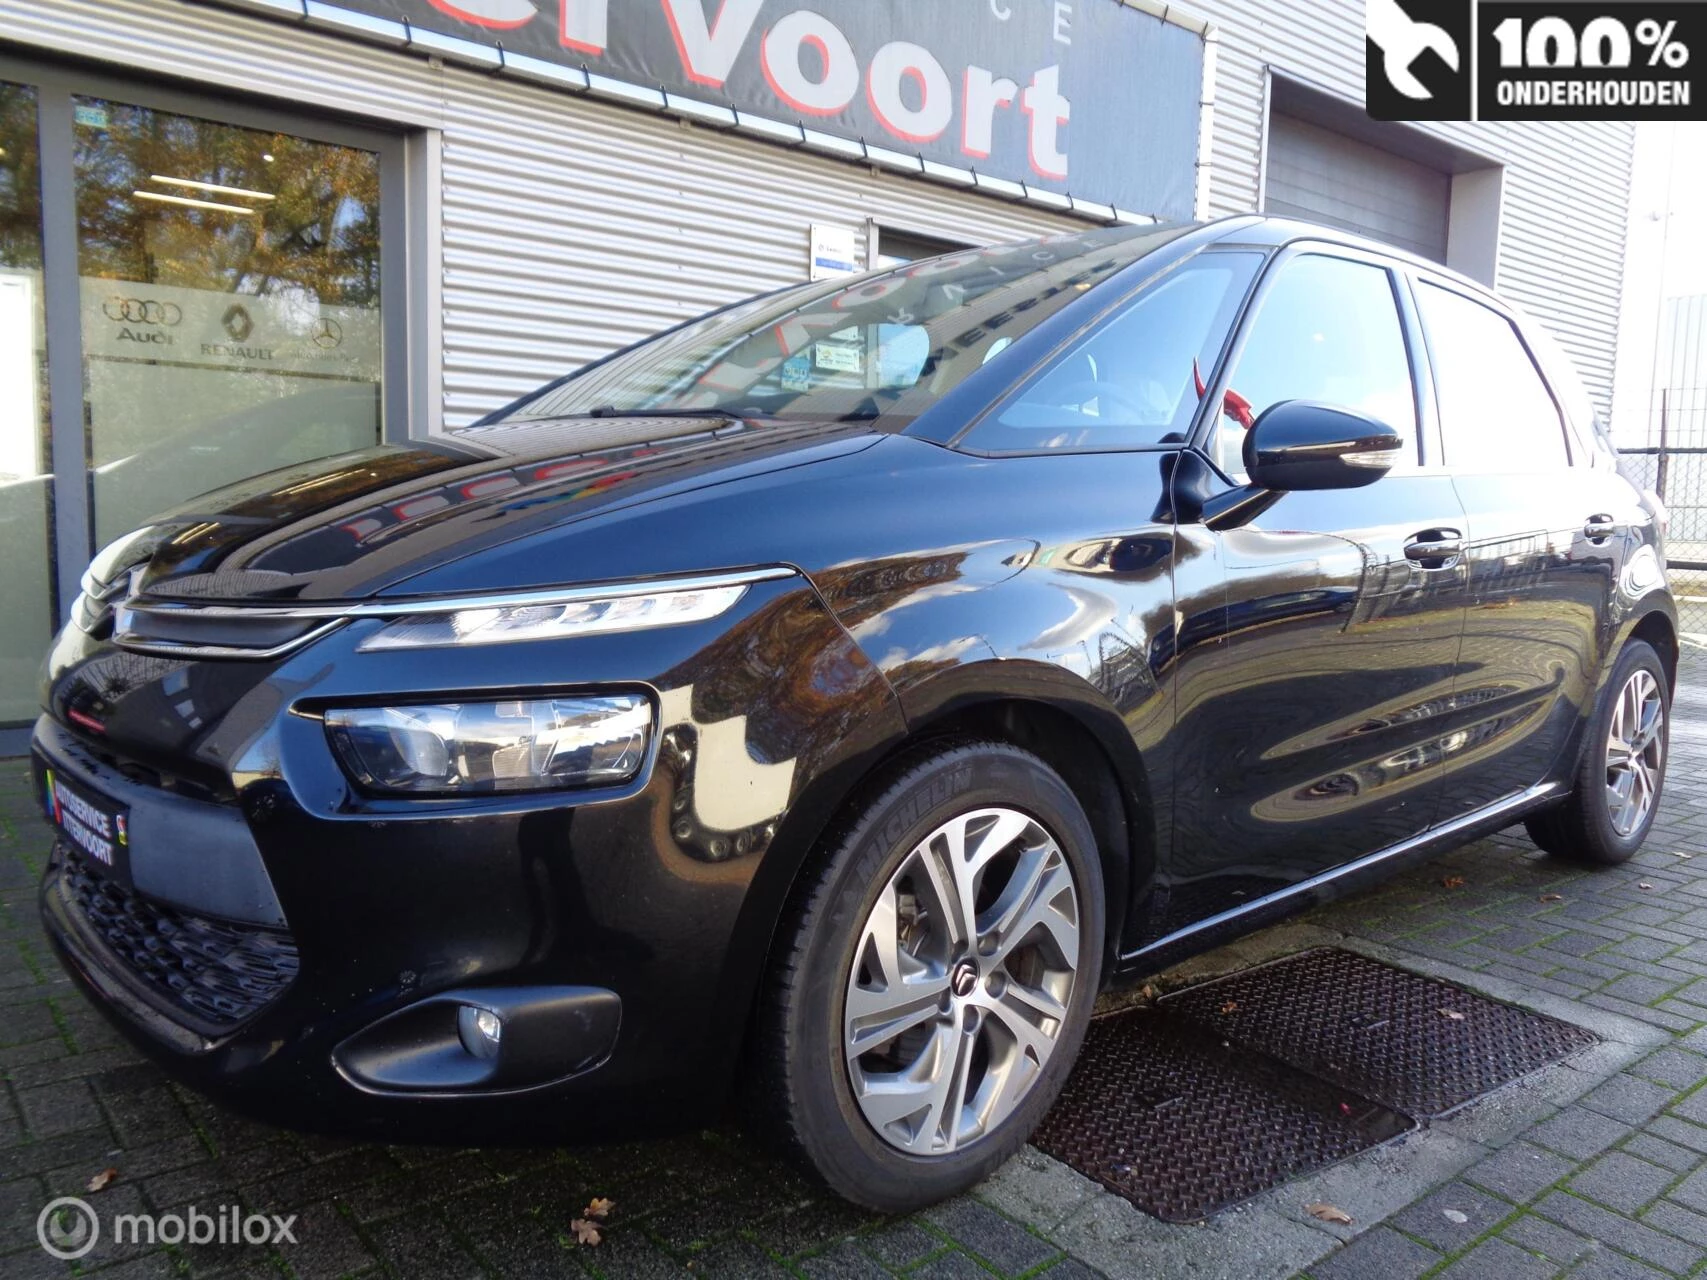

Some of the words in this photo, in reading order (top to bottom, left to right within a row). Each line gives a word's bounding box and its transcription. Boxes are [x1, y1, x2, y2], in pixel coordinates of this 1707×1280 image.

[425, 0, 1070, 180] voort
[200, 343, 274, 361] RENAULT
[855, 763, 974, 887] MICHELIN
